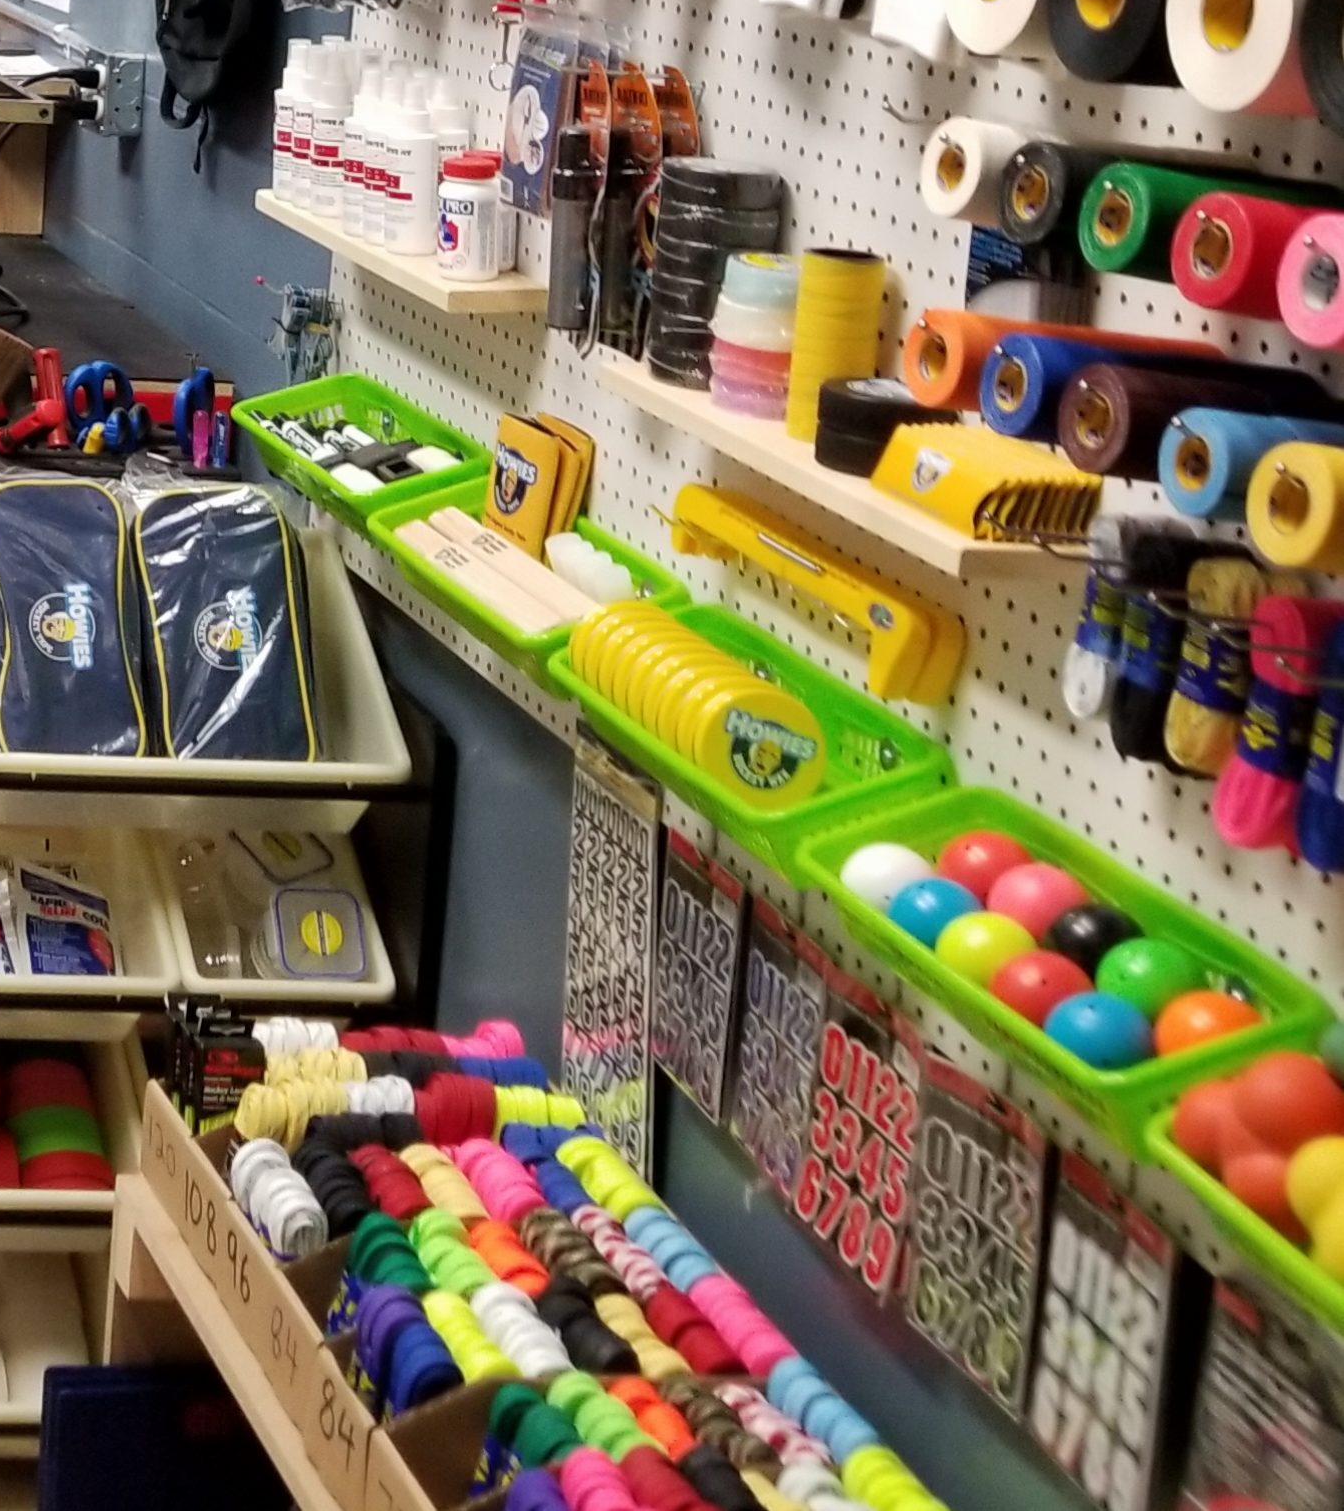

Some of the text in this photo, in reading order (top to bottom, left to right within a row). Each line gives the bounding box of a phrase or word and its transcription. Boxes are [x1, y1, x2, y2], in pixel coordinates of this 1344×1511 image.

[445, 200, 473, 214] PRO
[497, 442, 537, 484] HOWIES
[65, 584, 91, 669] HOWIES
[726, 708, 817, 760] HOWIES
[148, 1115, 176, 1178] 120
[185, 1169, 216, 1257] 108
[227, 1229, 251, 1303] 96
[269, 1305, 298, 1383] 84
[319, 1378, 355, 1472] 84
